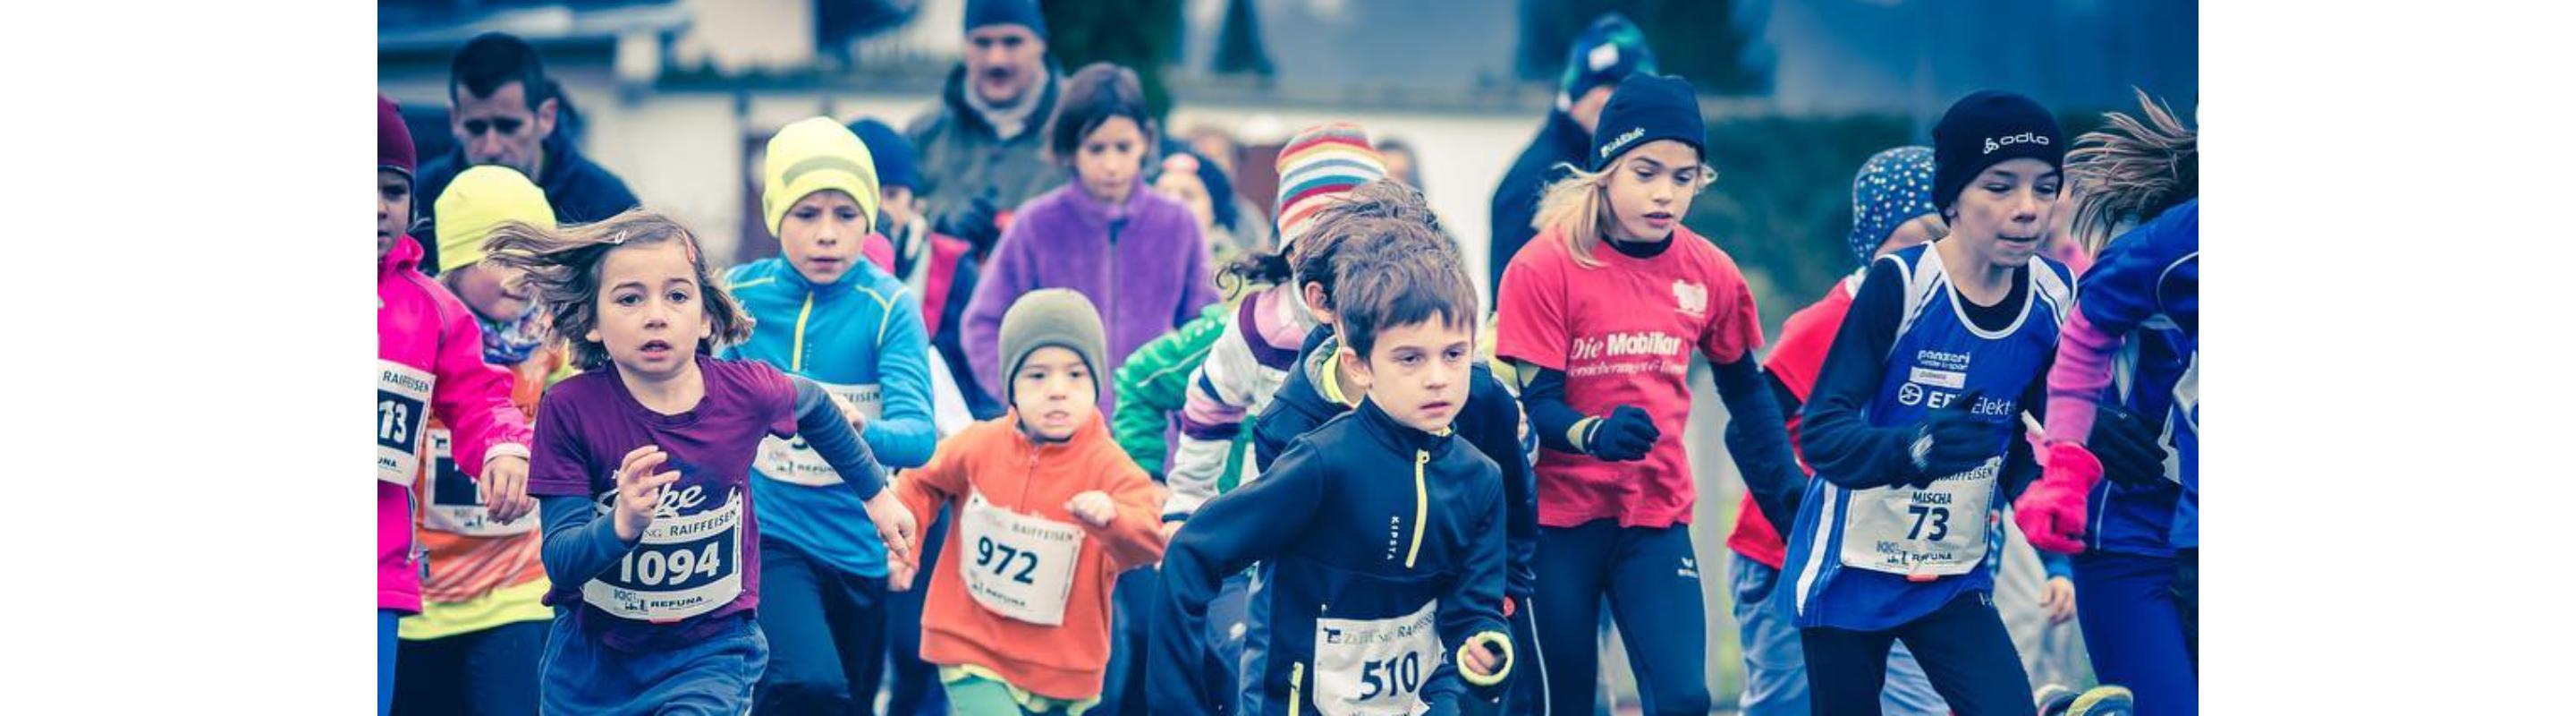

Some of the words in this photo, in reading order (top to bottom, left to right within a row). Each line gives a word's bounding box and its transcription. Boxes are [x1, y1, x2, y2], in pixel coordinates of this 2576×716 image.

[1999, 132, 2049, 145] odlo
[1570, 337, 1604, 360] Die
[1606, 332, 1682, 355] Mobiliar
[1918, 350, 1970, 363] panzeri
[1911, 492, 1952, 504] MISCHA
[670, 509, 736, 537] RAIFFEISEN
[1906, 505, 1950, 541] 73
[1386, 516, 1400, 560] KIPSTA
[621, 541, 721, 585] 1094
[977, 535, 1038, 585] 972
[650, 595, 703, 609] REFUNA
[1359, 651, 1419, 701] 510
